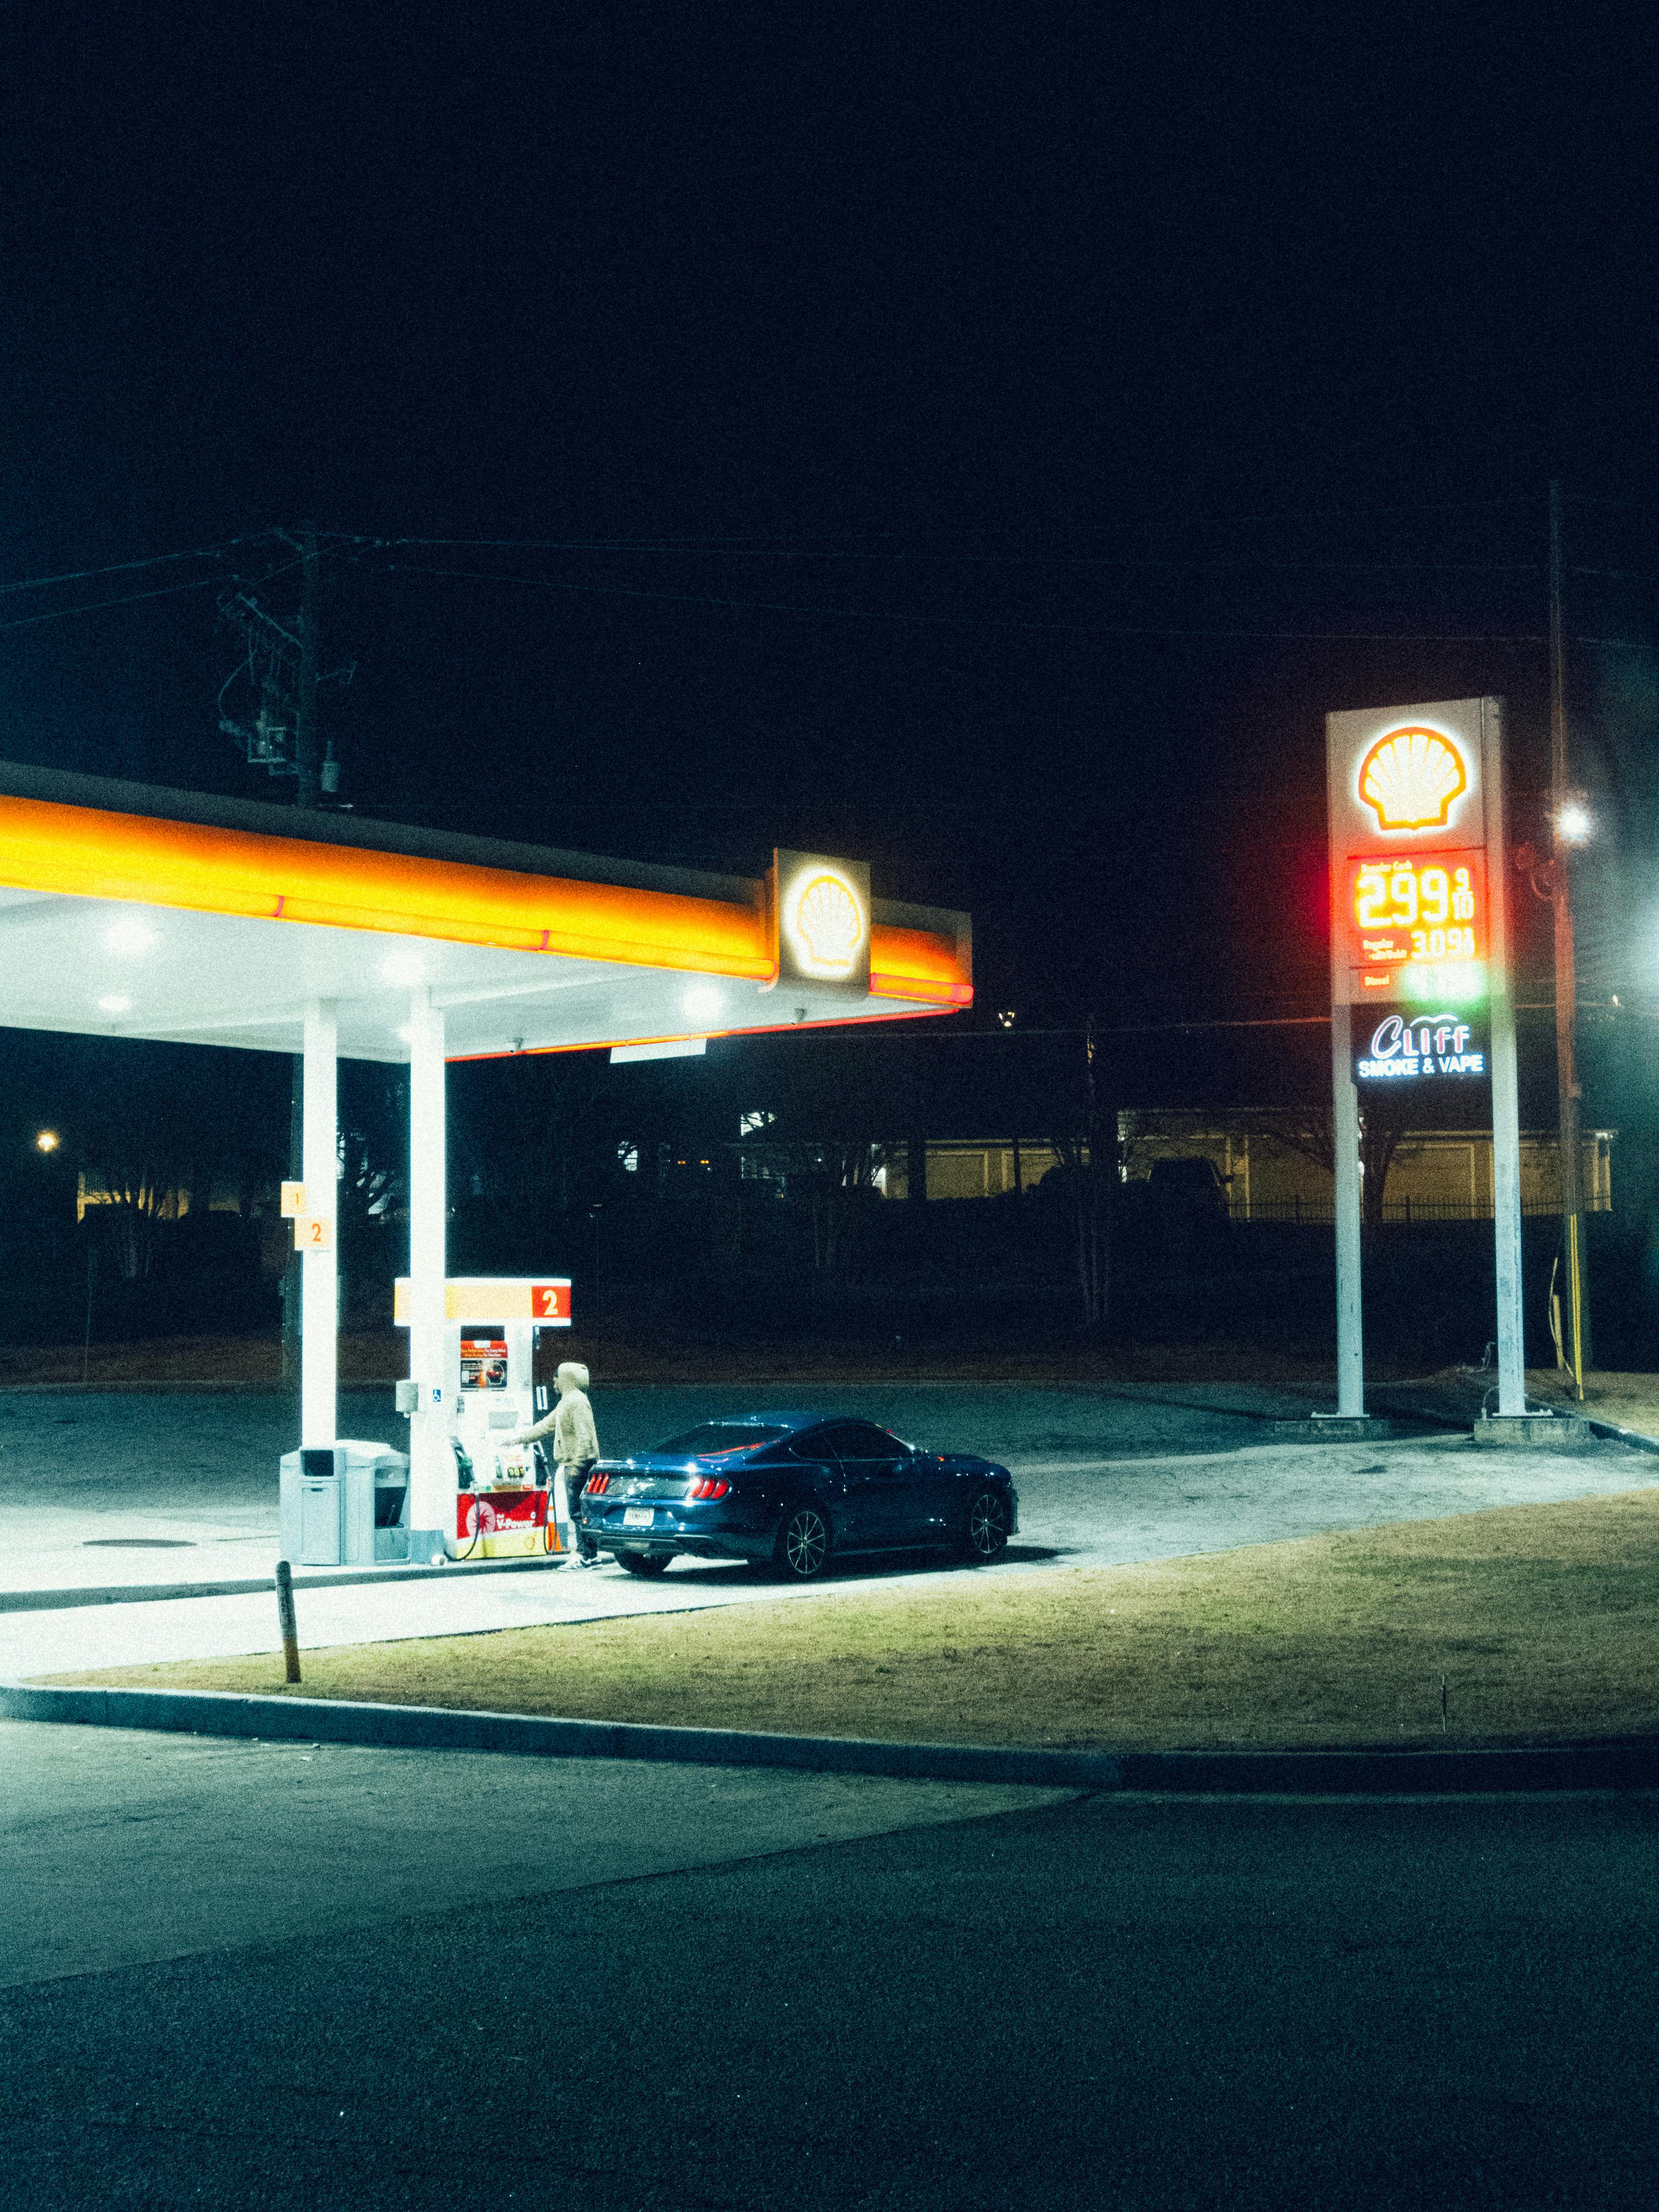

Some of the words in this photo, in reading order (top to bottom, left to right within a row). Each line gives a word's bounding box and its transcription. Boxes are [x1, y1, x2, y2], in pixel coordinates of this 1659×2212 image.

[1359, 1058, 1419, 1078] SMOKE
[1422, 1057, 1435, 1074] &
[1438, 1054, 1484, 1073] VAPE
[295, 1193, 300, 1205] 1
[311, 1223, 322, 1242] 2
[542, 1289, 558, 1316] 2
[496, 1518, 536, 1530] V-Power
